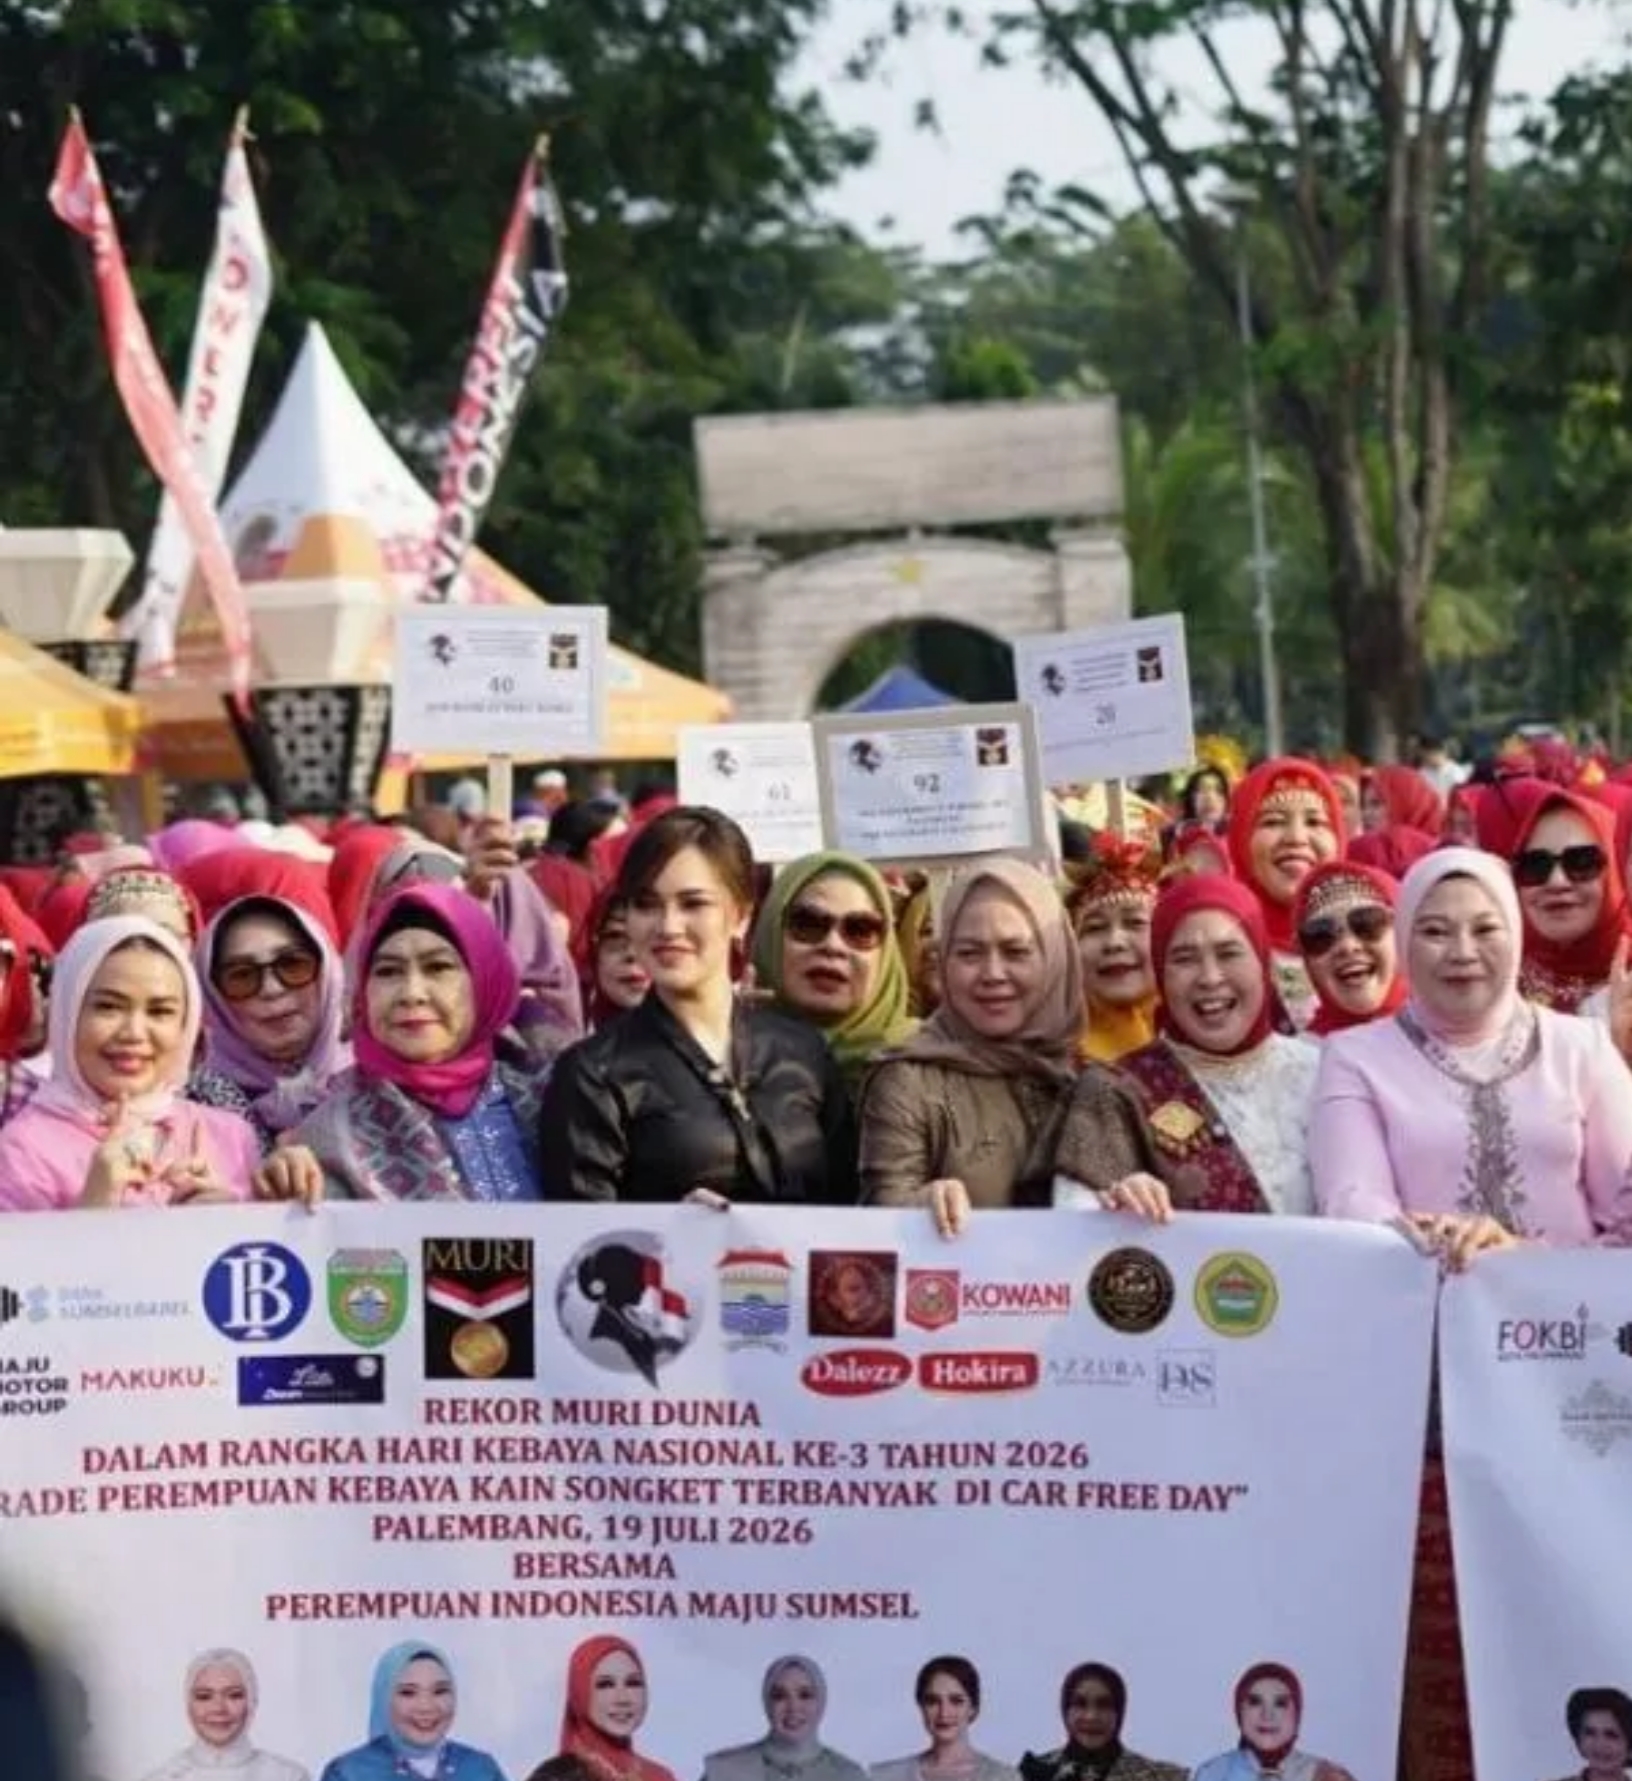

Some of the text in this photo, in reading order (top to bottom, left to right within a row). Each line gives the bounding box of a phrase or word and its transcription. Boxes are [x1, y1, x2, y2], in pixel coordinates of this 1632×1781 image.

[489, 676, 515, 694] 40
[914, 773, 941, 794] 92
[426, 1239, 532, 1271] MURI
[961, 1282, 1072, 1310] KOWANI
[80, 1367, 206, 1393] MAKUKU
[809, 1357, 903, 1386] Dalezz
[932, 1359, 1028, 1386] Hokira
[0, 1398, 68, 1416] ROUP
[423, 1397, 762, 1428] REKOR MURI DUNIA
[82, 1436, 1090, 1475] DALAM RANGKA HARI KEBAYA NASIONAL KE-3 TAHUN 2026
[97, 1478, 317, 1513] PEREMPUAN
[328, 1476, 460, 1504] KEBAYA
[470, 1475, 554, 1501] KAIN
[564, 1475, 724, 1505] SONGKET
[731, 1478, 938, 1508] TERBANYAK
[955, 1479, 991, 1506] DI
[1000, 1479, 1068, 1508] CAR
[1076, 1481, 1160, 1511] FREE
[372, 1514, 814, 1546] PALEMBANG, 19 JULI 2026
[513, 1552, 677, 1580] BERSAMA
[265, 1590, 920, 1625] PEREMPUAN INDONESIA MAJU SUMSEL
